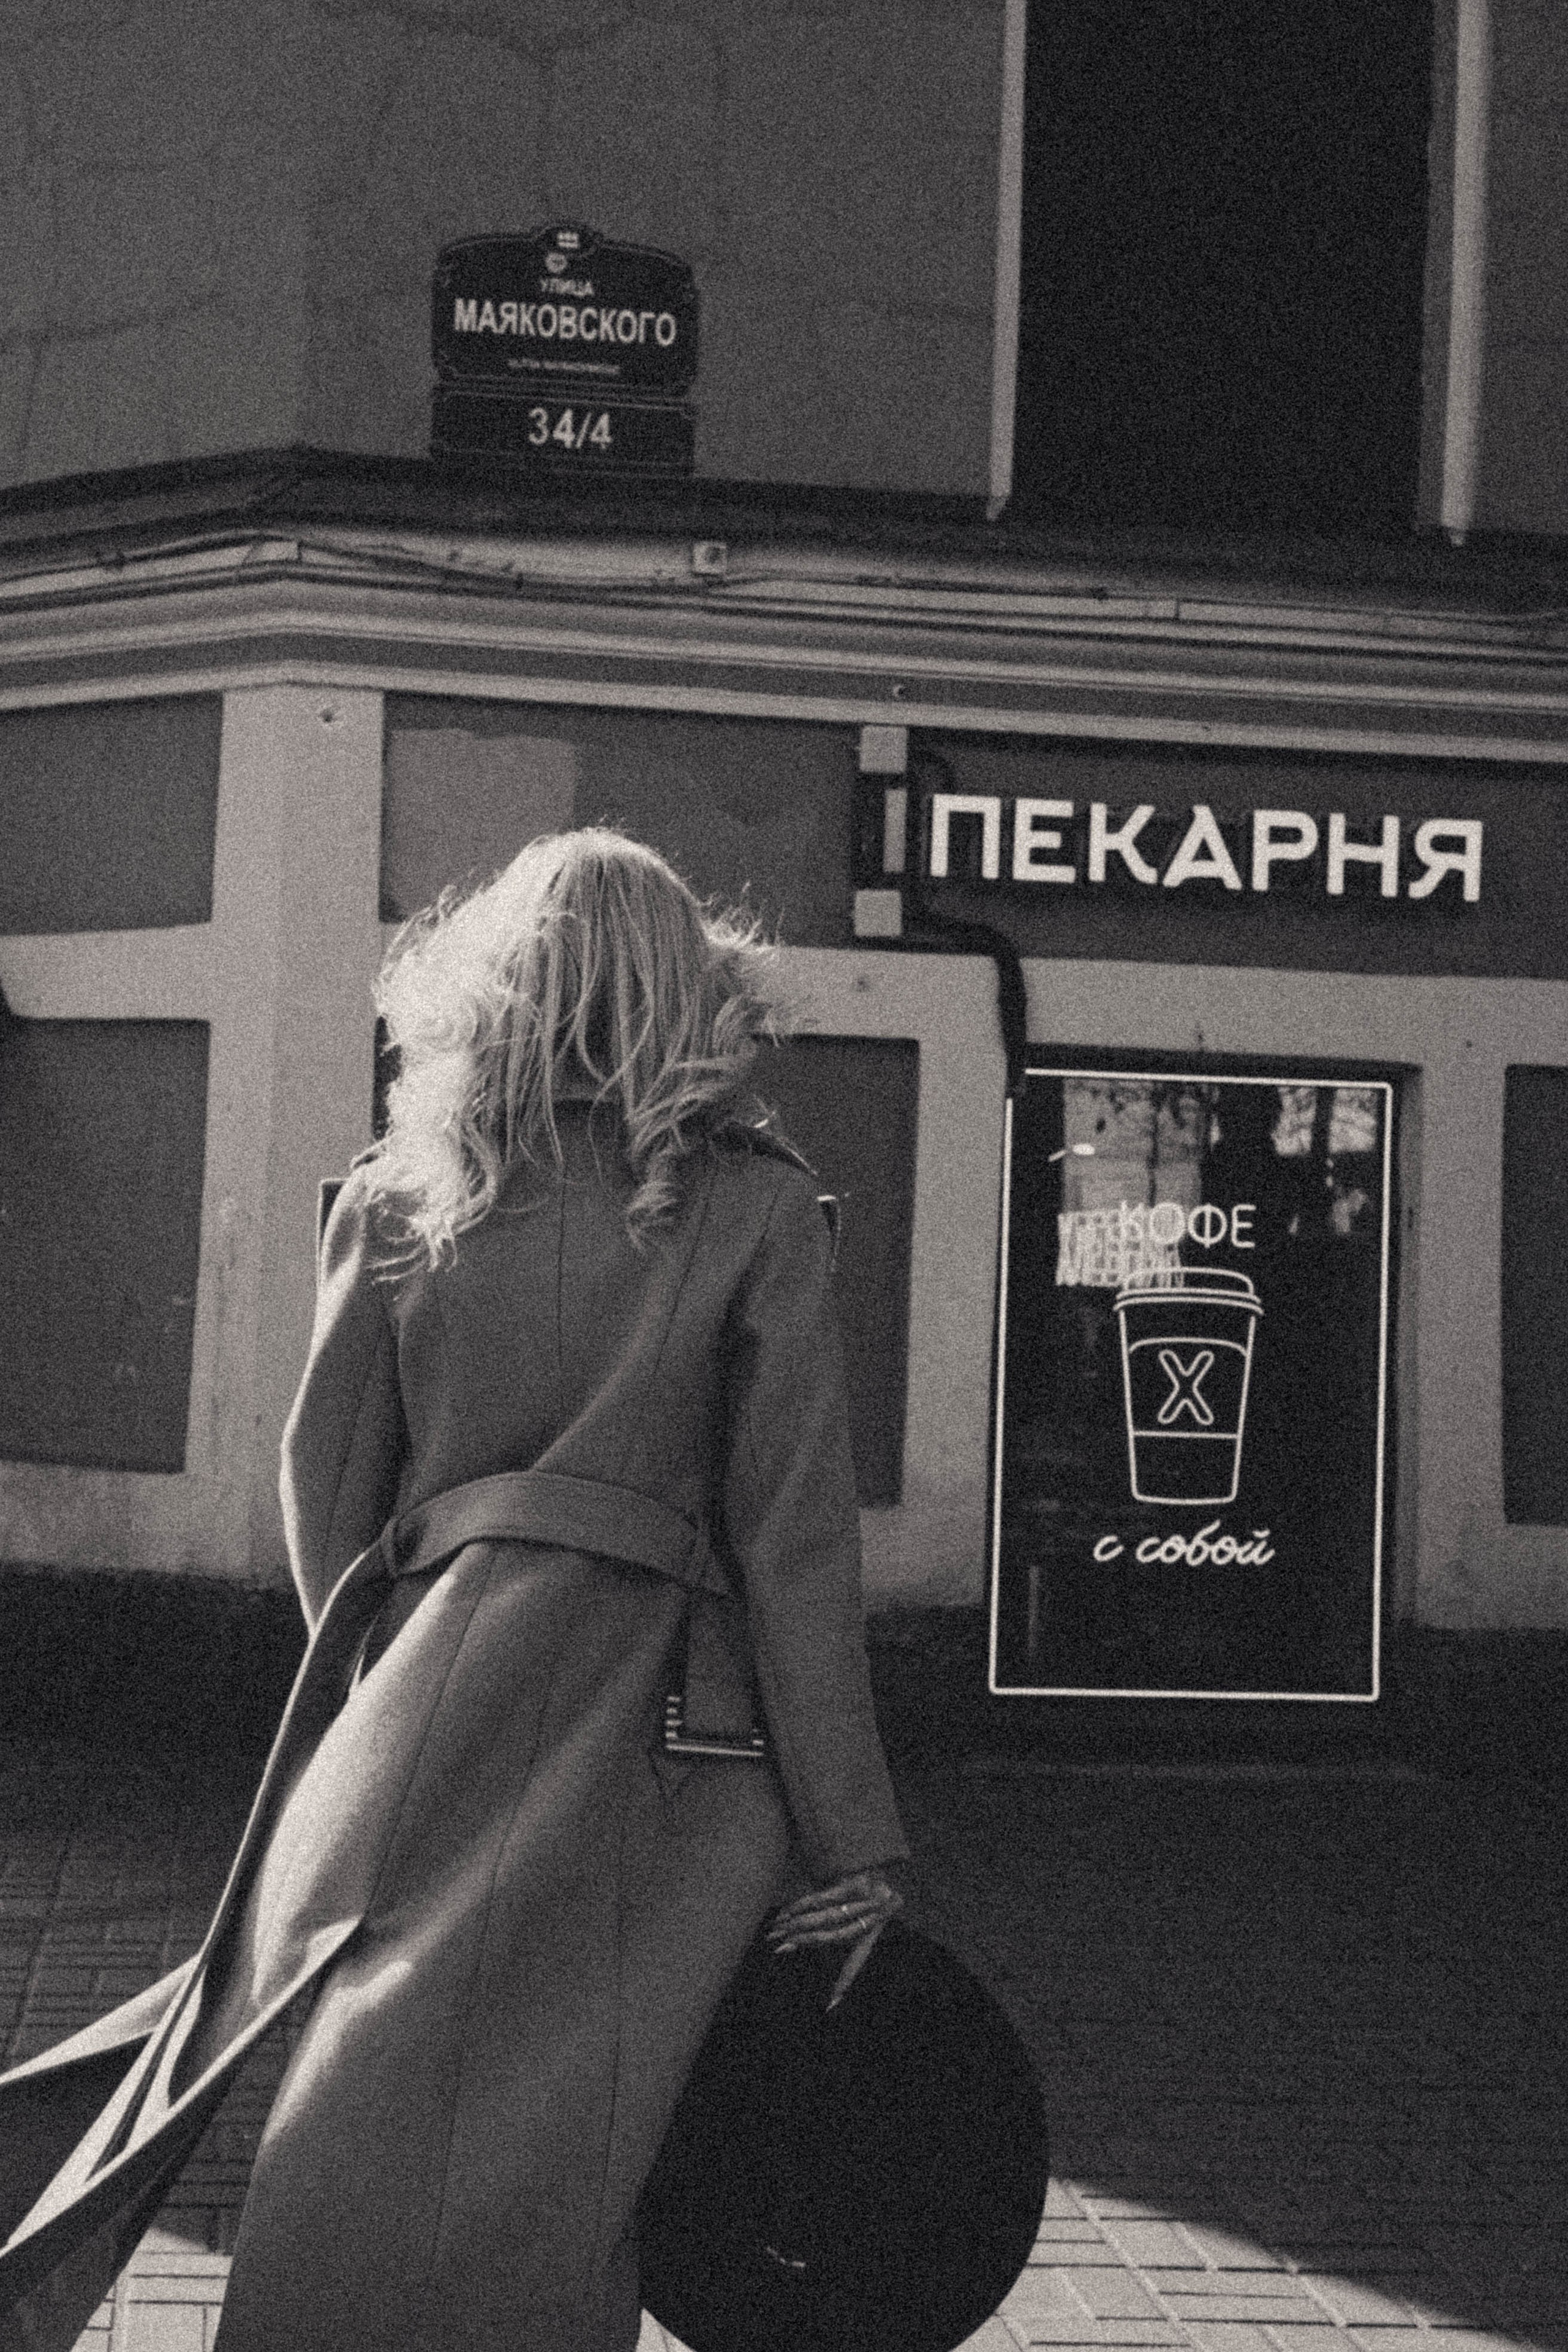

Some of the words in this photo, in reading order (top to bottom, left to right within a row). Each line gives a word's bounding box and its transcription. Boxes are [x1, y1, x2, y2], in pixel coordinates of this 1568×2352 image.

[540, 278, 594, 298] УЛИЦА
[454, 297, 677, 347] МАЯКОВСКОГО
[528, 407, 613, 450] 34/4
[929, 793, 1483, 902] ПЕКАРНЯ
[1120, 1199, 1257, 1250] КОФЕ
[1093, 1535, 1125, 1562] с
[1135, 1518, 1276, 1567] собой
